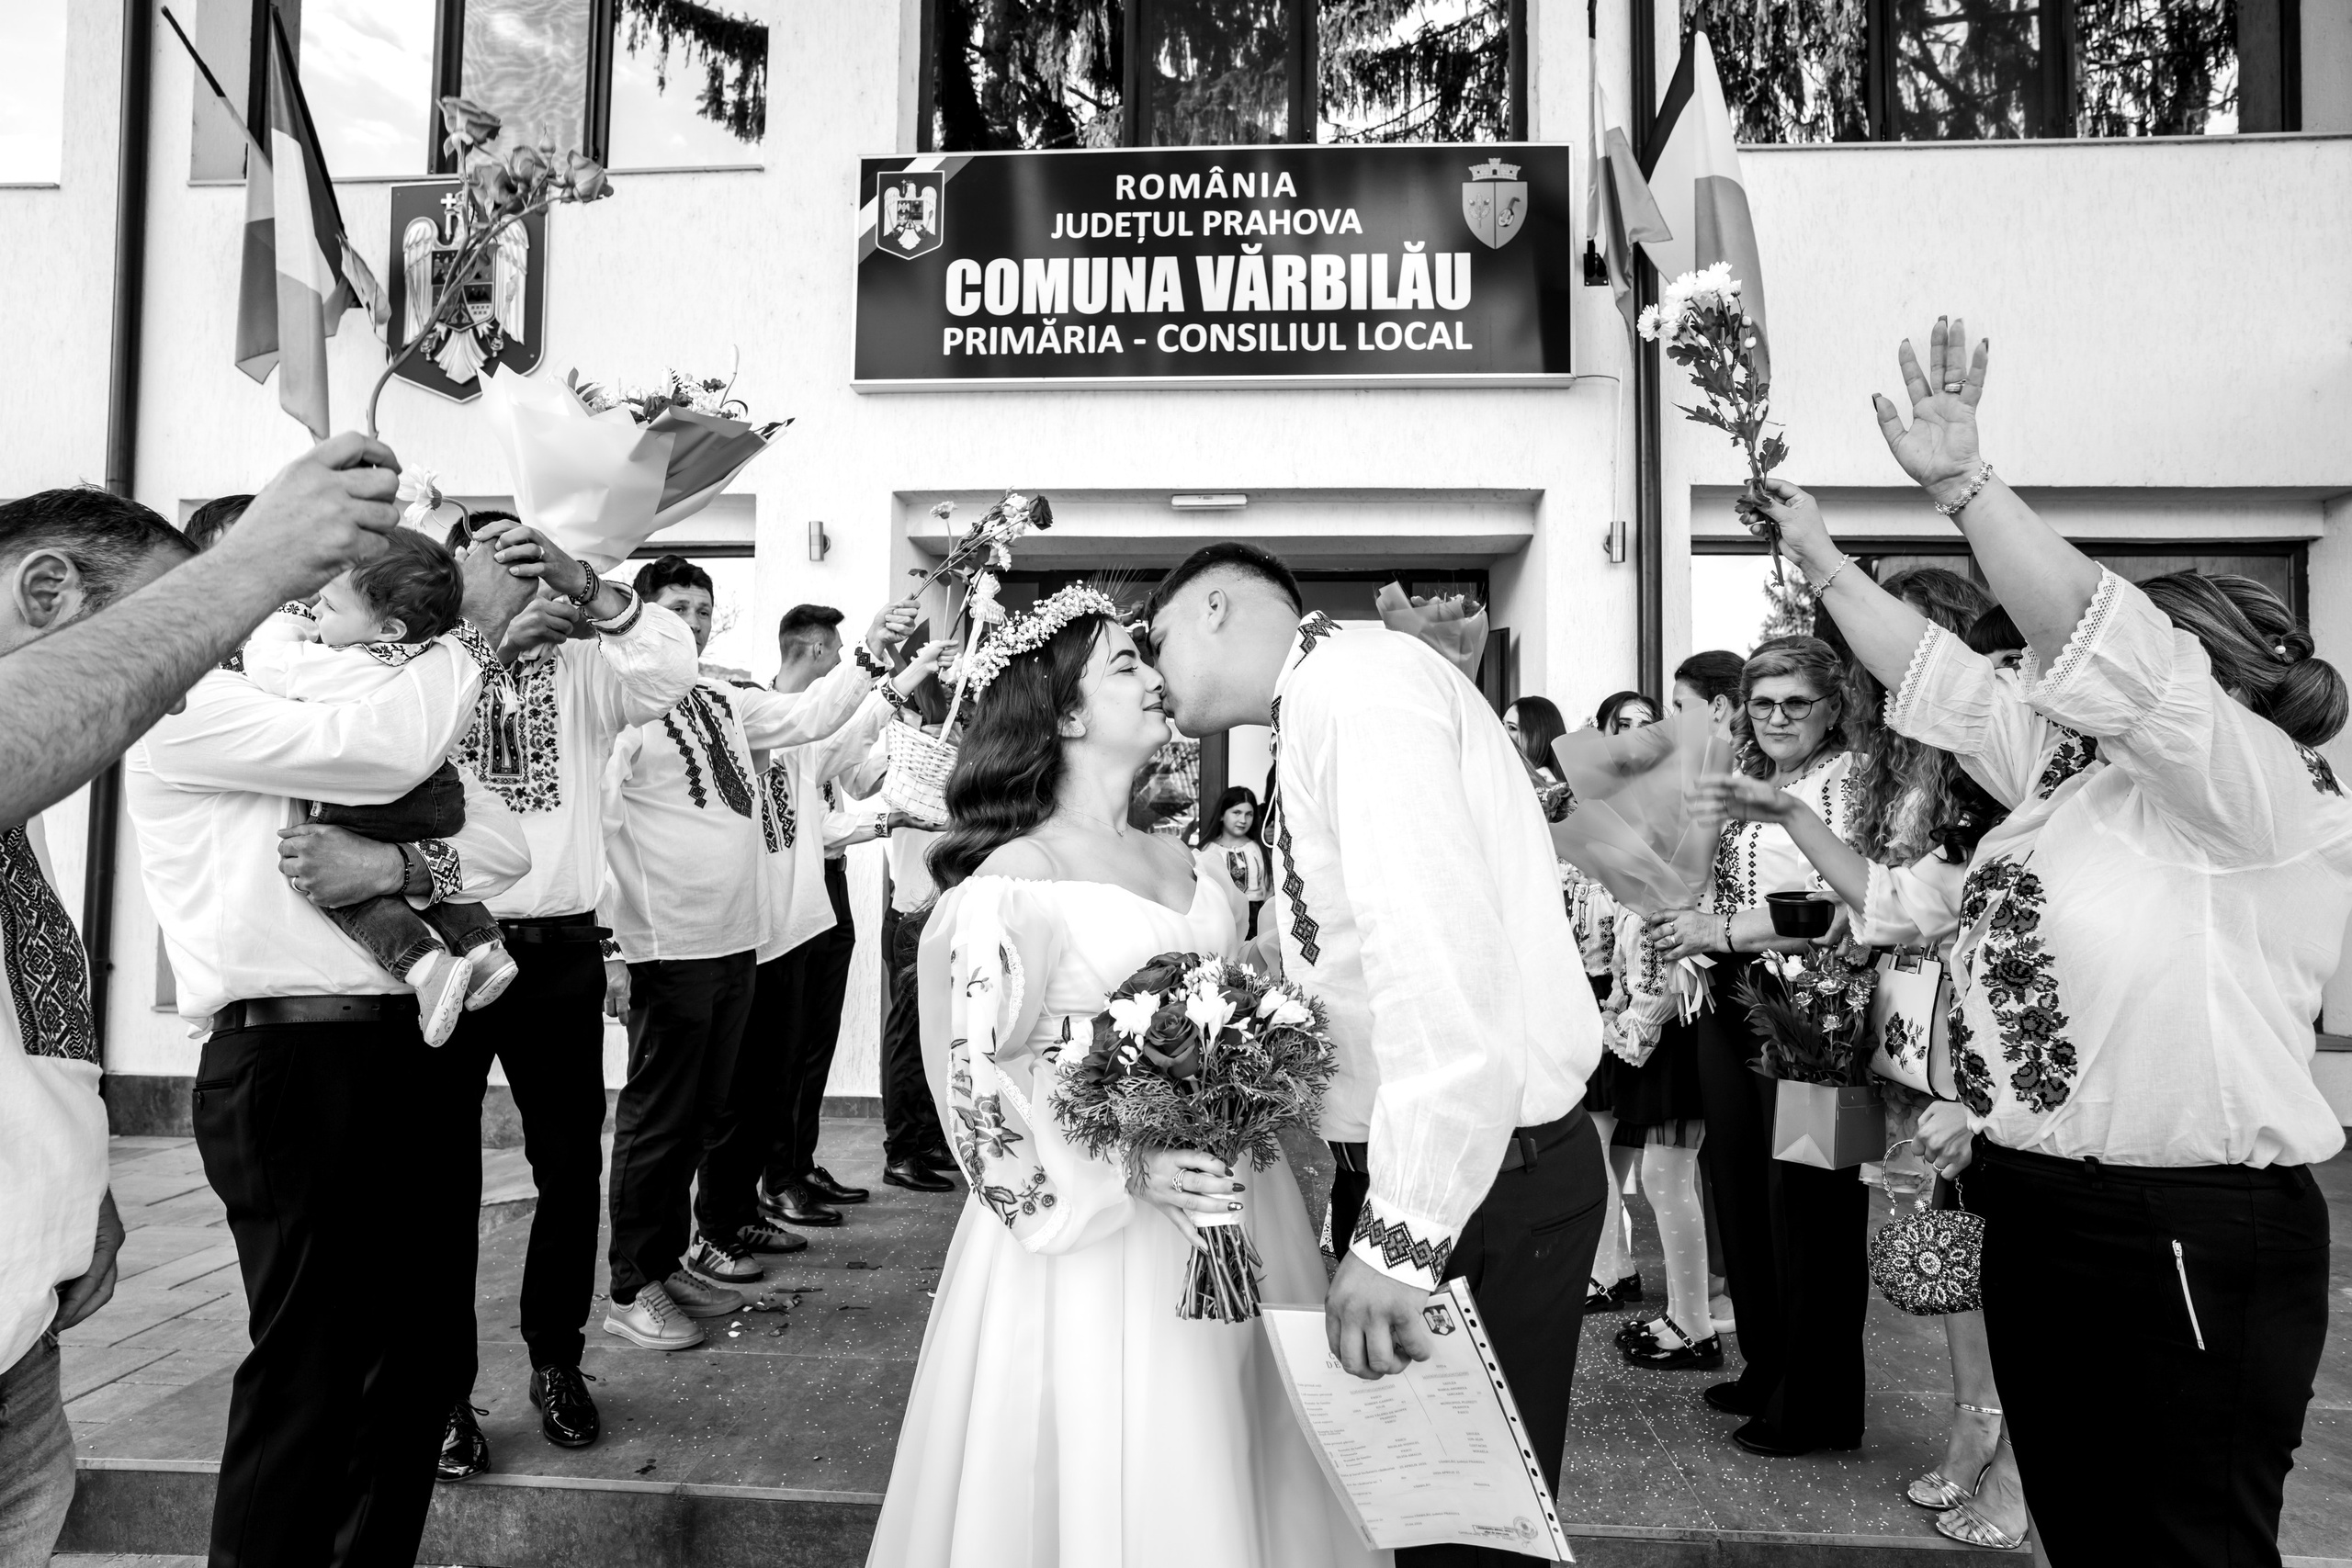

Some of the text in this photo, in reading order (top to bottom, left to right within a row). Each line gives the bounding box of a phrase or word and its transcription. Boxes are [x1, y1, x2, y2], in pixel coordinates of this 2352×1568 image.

[1115, 165, 1297, 200] ROMÂNIA
[1050, 208, 1363, 244] JUDEȚUL PRAHOVA
[945, 240, 1472, 317] COMUNA VĂRBILĂU
[943, 317, 1124, 355] PRIMĂRIA
[1157, 322, 1347, 353] CONSILIUL
[1358, 321, 1474, 351] LOCAL
